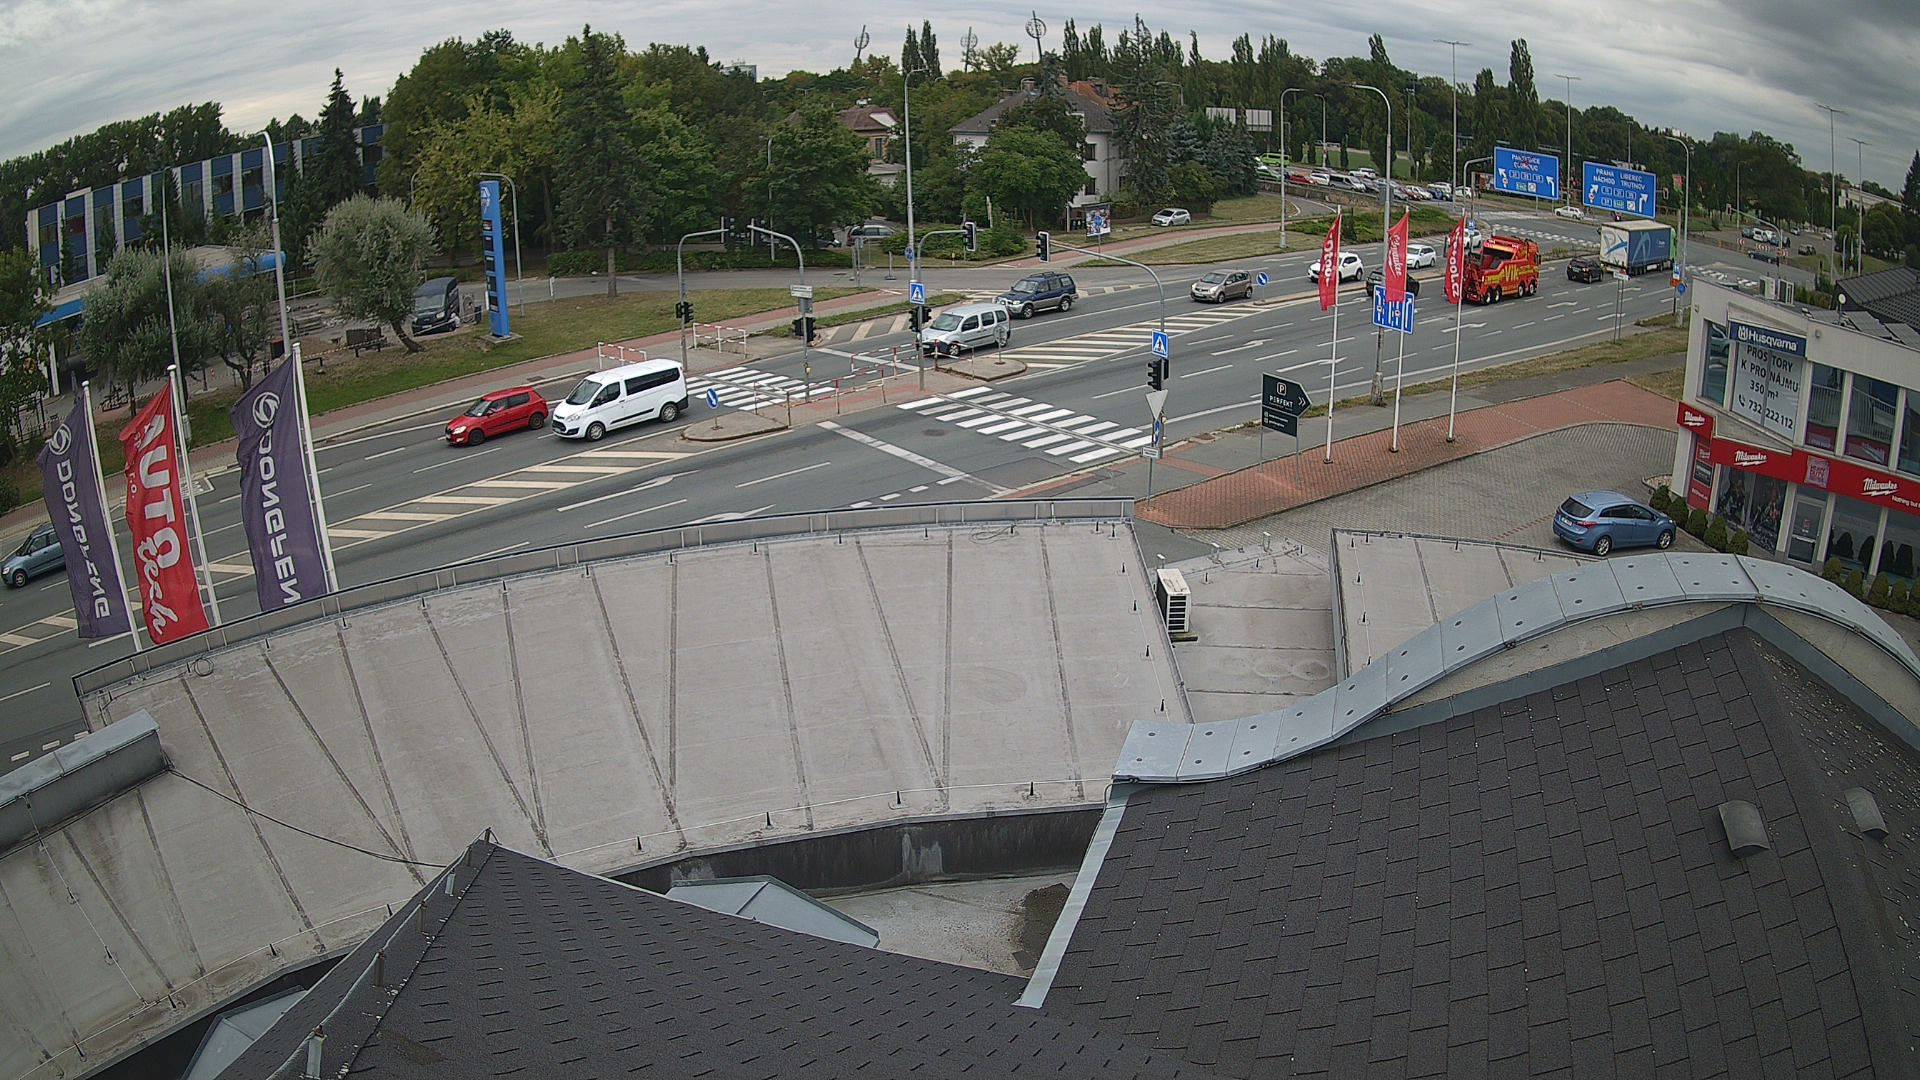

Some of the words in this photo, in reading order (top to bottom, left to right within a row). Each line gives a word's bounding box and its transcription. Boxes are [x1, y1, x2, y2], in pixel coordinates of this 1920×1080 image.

[1748, 329, 1797, 351] Husqvarna
[1741, 359, 1747, 370] K
[1750, 380, 1765, 394] 350
[1748, 400, 1762, 415] 732
[1735, 449, 1767, 462] Milwaukee
[1863, 477, 1898, 491] Milwaukee
